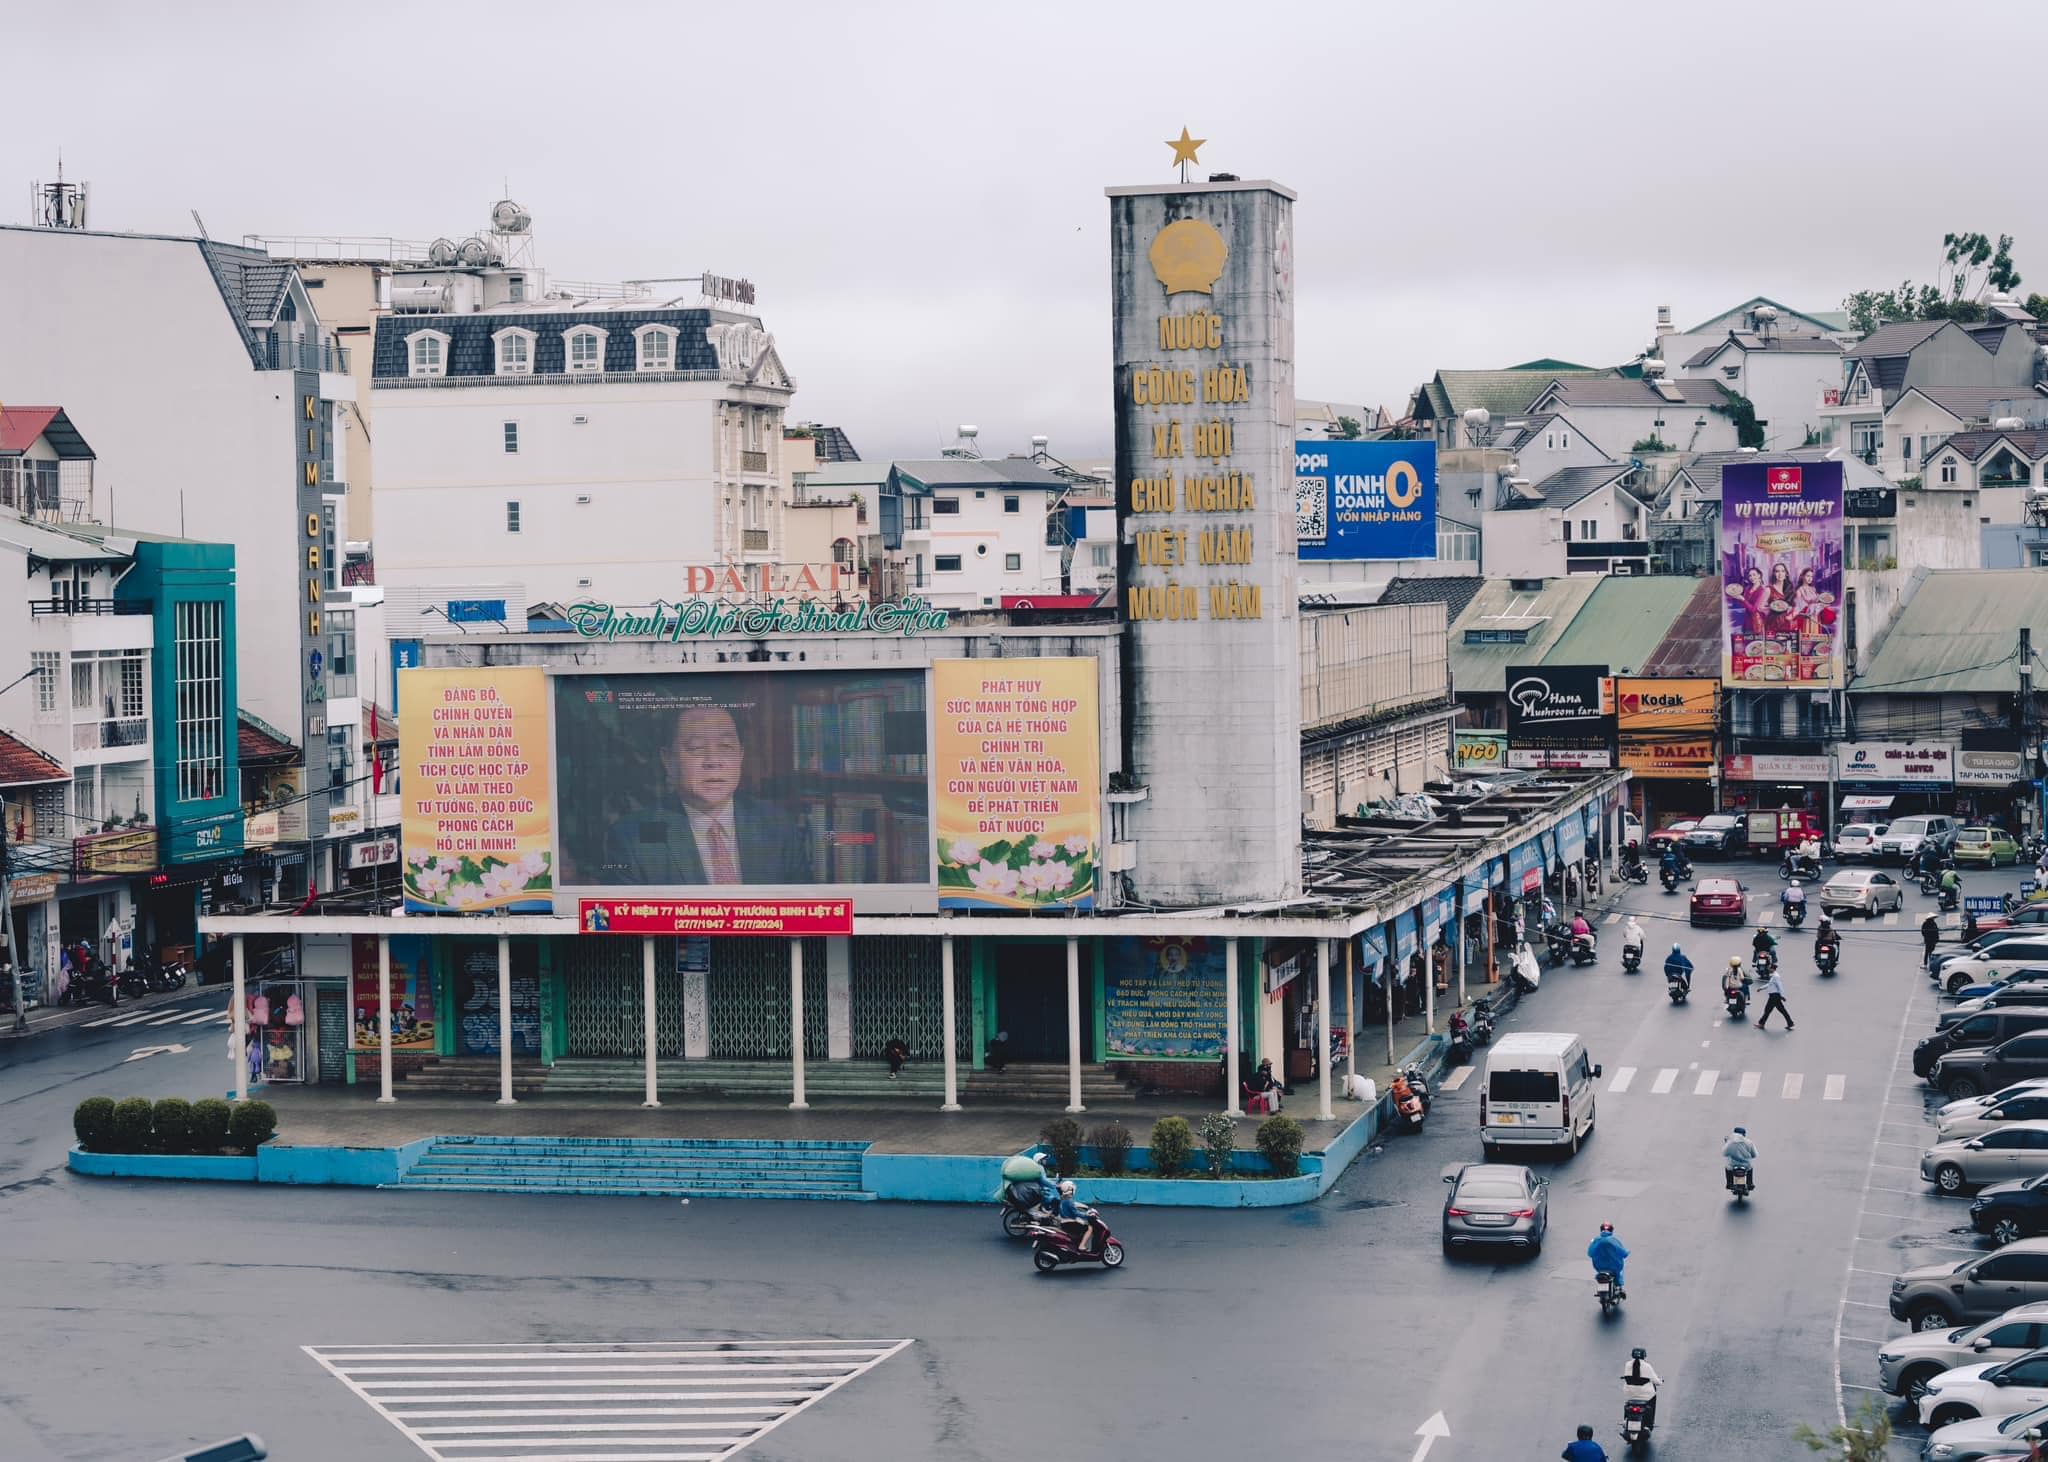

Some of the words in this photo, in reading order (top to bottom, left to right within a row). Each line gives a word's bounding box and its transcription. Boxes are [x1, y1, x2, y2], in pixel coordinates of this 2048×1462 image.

[1159, 311, 1222, 350] NƯỚC
[1133, 365, 1195, 412] CỘNG
[1204, 361, 1248, 403] HÒA
[305, 395, 319, 486] KIM
[1153, 420, 1183, 458] XÃ
[1194, 417, 1231, 465] HỘI
[1131, 468, 1176, 512] CHỦ
[1184, 470, 1256, 512] NGHĨA
[1335, 475, 1384, 494] KINH
[1771, 482, 1798, 491] VIFON
[1336, 496, 1384, 508] DOANH
[1754, 502, 1778, 518] TRỤ
[1806, 499, 1835, 517] VIỆT
[1336, 508, 1360, 522] VỐN
[1361, 509, 1390, 524] NHẬP
[1392, 510, 1421, 522] HÀNG
[1136, 528, 1186, 573] VIỆT
[1199, 530, 1251, 565] NAM
[307, 513, 320, 636] OANH
[1129, 580, 1196, 620] MUÔN
[1210, 578, 1261, 619] NĂM
[567, 603, 665, 642] Thành
[672, 601, 743, 642] Phố
[741, 597, 866, 636] Festival
[870, 595, 948, 636] Hoa
[982, 678, 1013, 693] PHÁT
[1018, 680, 1041, 692] HUY
[444, 687, 476, 701] ĐẢNG
[480, 687, 500, 703] BỘ,
[1550, 693, 1582, 704] Hana
[1641, 694, 1683, 706] Kodak
[433, 706, 469, 721] CHÍNH
[474, 702, 512, 721] QUYỀN
[947, 698, 971, 713] SỨC
[975, 700, 1011, 715] MẠNH
[1015, 696, 1047, 713] TỔNG
[1052, 700, 1077, 715] HỢP
[1521, 705, 1575, 717] Mushroom
[434, 724, 449, 739] VÀ
[453, 724, 484, 738] NHÂN
[489, 724, 512, 738] DÂN
[958, 718, 982, 733] CỦA
[986, 718, 1002, 732] CẢ
[1007, 718, 1022, 735] HỆ
[1026, 716, 1067, 732] THỐNG
[428, 743, 454, 757] TỈNH
[459, 743, 482, 757] LÂM
[487, 741, 519, 757] ĐỒNG
[982, 738, 1020, 752] CHÍNH
[1024, 741, 1043, 755] TRỊ
[1654, 747, 1707, 758] DALAT
[419, 763, 446, 776] TÍCH
[451, 763, 475, 778] CỰC
[479, 764, 502, 778] HỌC
[507, 762, 529, 778] TẬP
[960, 759, 976, 772] VÀ
[980, 757, 1004, 772] NỀN
[1008, 759, 1032, 772] VĂN
[1036, 759, 1065, 773] HÓA,
[436, 781, 451, 794] VÀ
[455, 780, 479, 794] LÀM
[484, 783, 513, 794] THEO
[949, 781, 974, 793] CON
[978, 778, 1015, 793] NGƯỜI
[1019, 778, 1046, 795] VIỆT
[1050, 780, 1078, 793] NAM
[417, 800, 432, 813] TƯ
[436, 798, 478, 814] TƯỞNG,
[481, 801, 505, 816] ĐẠO
[509, 799, 533, 812] ĐỨC
[968, 797, 984, 813] ĐỂ
[988, 799, 1019, 812] PHÁT
[1023, 796, 1059, 812] TRIỂN
[439, 820, 477, 832] PHONG
[482, 817, 514, 831] CÁCH
[979, 817, 1002, 832] ĐẤT
[1006, 818, 1044, 832] NƯỚC!
[197, 829, 215, 847] BIDV
[437, 835, 451, 850] HỒ
[457, 837, 477, 850] CHÍ
[481, 838, 516, 850] MINH!
[614, 903, 628, 916] KỶ
[632, 905, 658, 918] NIỆM
[661, 907, 673, 917] 77
[675, 905, 699, 916] NĂM
[701, 904, 731, 916] NGÀY
[735, 906, 777, 917] THƯƠNG
[779, 907, 806, 916] BINH
[808, 905, 831, 918] LIỆT
[834, 904, 844, 916] SĨ
[1992, 900, 2001, 909] XE
[674, 919, 724, 930] (27/7/1947
[732, 919, 783, 930] 27/7/2024)
